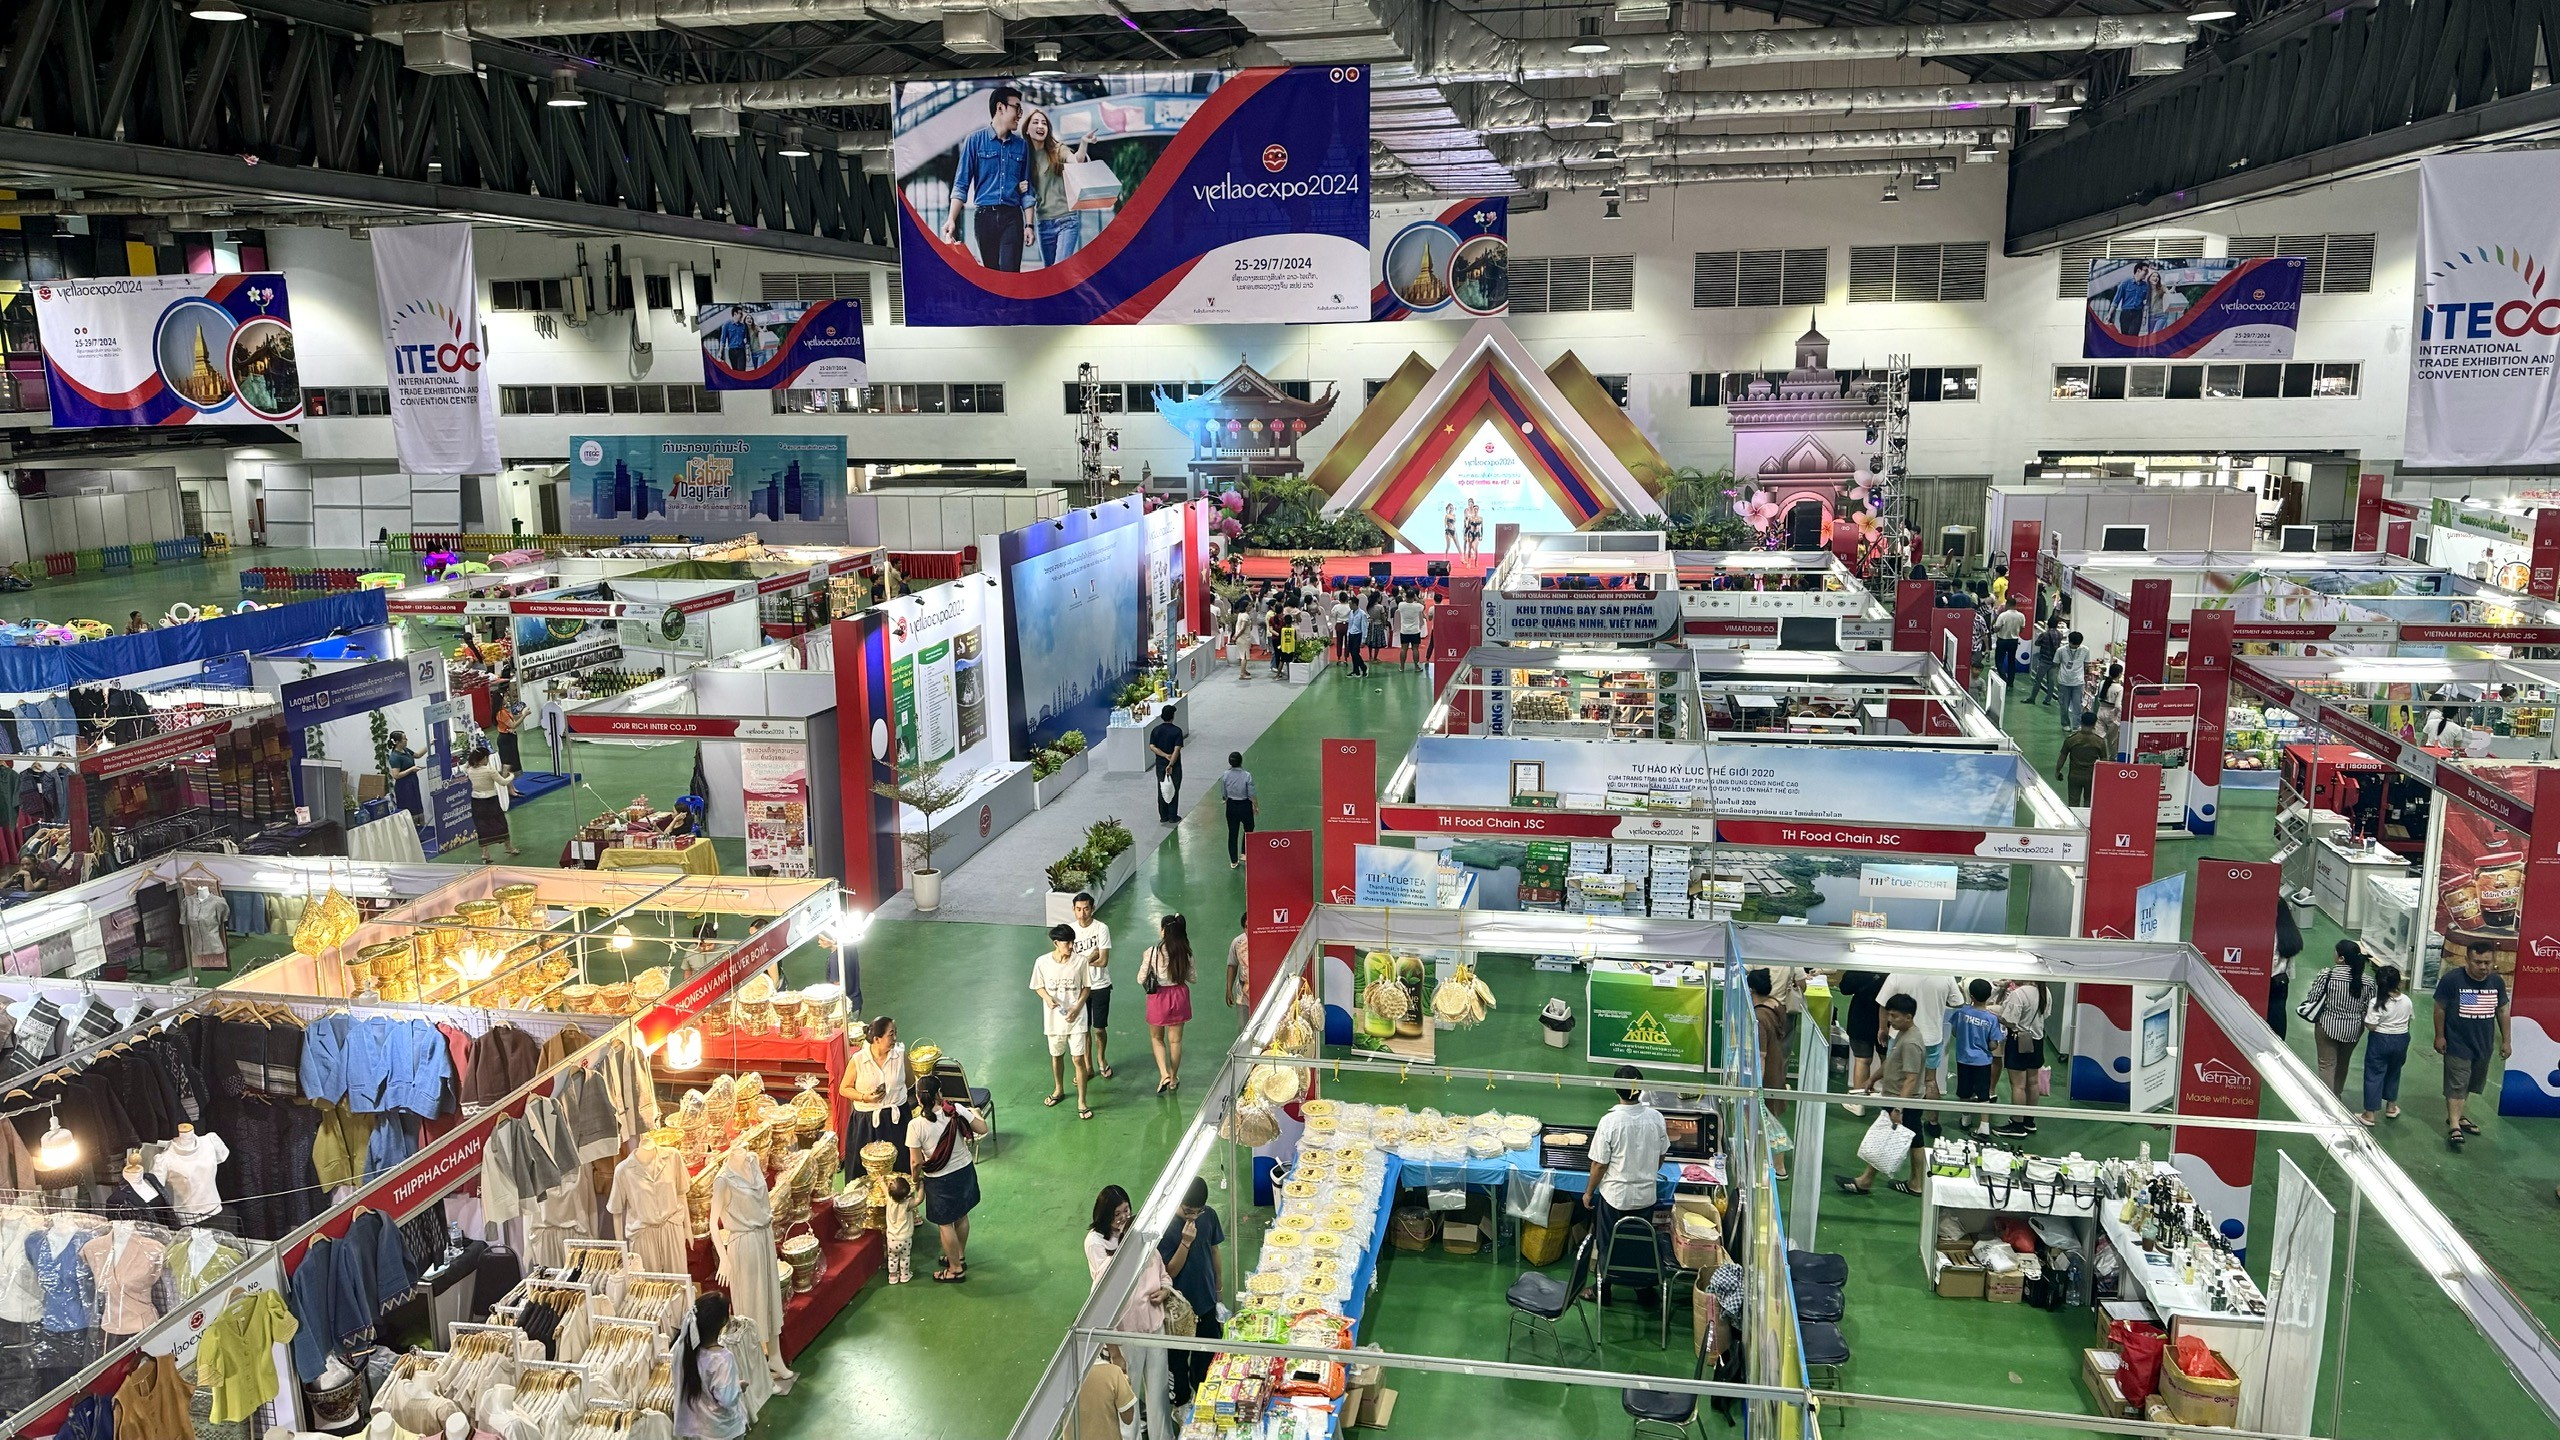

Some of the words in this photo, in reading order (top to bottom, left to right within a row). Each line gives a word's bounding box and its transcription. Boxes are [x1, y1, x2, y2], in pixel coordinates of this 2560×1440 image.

[1234, 257, 1312, 271] 25-29/7/2024
[2419, 343, 2523, 355] INTERNATIONAL
[395, 342, 481, 374] ITECC
[2418, 357, 2459, 368] TRADE
[2462, 355, 2529, 367] EXHIBITION
[2531, 354, 2555, 364] AND
[2418, 368, 2500, 380] CONVENTION
[2502, 366, 2550, 378] CENTER
[398, 376, 459, 386] INTERNATIONAL
[423, 386, 466, 395] EXHIBITION
[467, 386, 479, 394] AND
[400, 397, 449, 406] CONVENTION
[449, 396, 478, 404] CENTER
[708, 454, 734, 471] Happy
[686, 460, 733, 486] Labor
[680, 481, 705, 502] Day
[706, 484, 731, 499] Fair
[1516, 605, 1536, 615] KHU
[1511, 619, 1539, 628] OCOP
[1634, 619, 1658, 629] NAM
[2424, 630, 2458, 638] VIETNAM
[2492, 631, 2522, 639] PLASTIC
[418, 661, 434, 681] 25
[289, 695, 315, 708] LAOVIET
[302, 703, 318, 713] Bank
[670, 723, 697, 731] CO.,LTD
[1647, 764, 1668, 774] HÀO
[1670, 764, 1684, 775] KỶ
[1752, 768, 1775, 777] 2020
[2467, 787, 2476, 799] Ba
[2476, 790, 2488, 805] Thao
[1439, 816, 1452, 826] TH
[1455, 816, 1484, 827] Food
[1486, 817, 1521, 828] Chain
[1523, 819, 1545, 830] JSC
[1782, 829, 1796, 840] TH
[1800, 830, 1832, 842] Food
[1835, 831, 1873, 843] Chain
[1876, 834, 1900, 845] JSC
[1869, 878, 1883, 886] TH
[2140, 918, 2158, 934] true
[674, 969, 728, 1016] PHONESAVANH
[729, 955, 750, 977] SILVER
[750, 941, 769, 963] BOWL
[2194, 1062, 2251, 1085] Vietnam
[2185, 1093, 2210, 1102] Made
[2212, 1094, 2231, 1104] with
[2231, 1097, 2254, 1106] pride
[393, 1136, 481, 1204] THIPPHACHANH
[247, 1281, 261, 1292] No.
